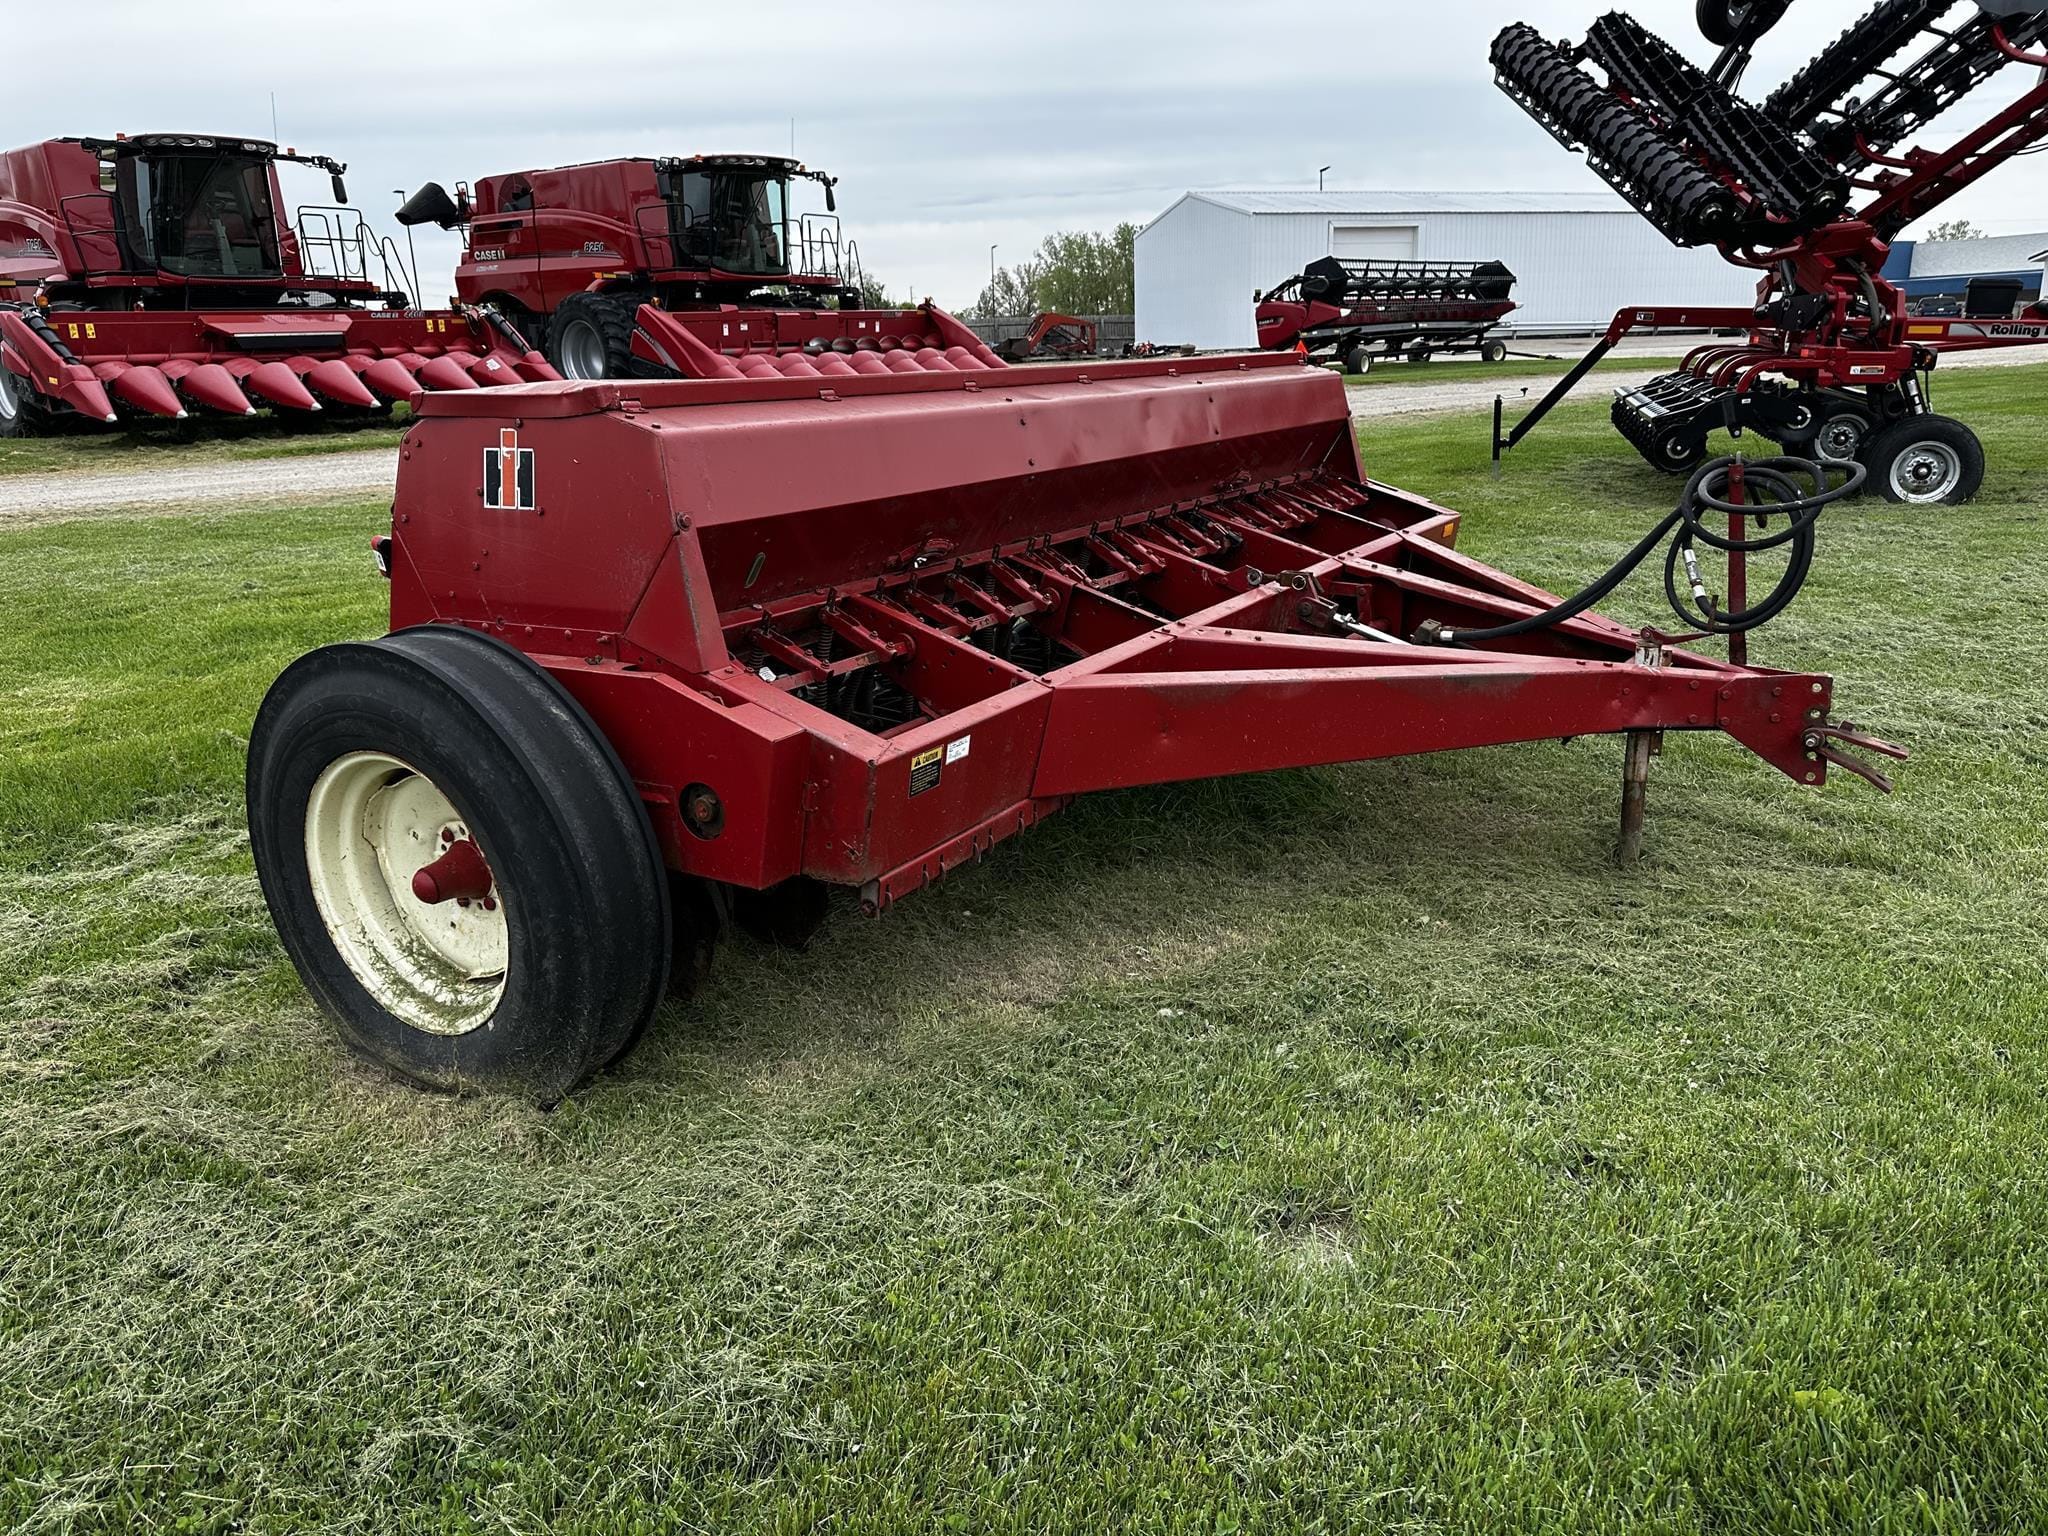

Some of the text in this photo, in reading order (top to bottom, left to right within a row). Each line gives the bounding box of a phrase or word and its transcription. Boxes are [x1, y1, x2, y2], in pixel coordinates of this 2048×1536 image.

[583, 241, 606, 253] 8250
[474, 250, 497, 261] CASE
[1990, 324, 2041, 338] Rolling
